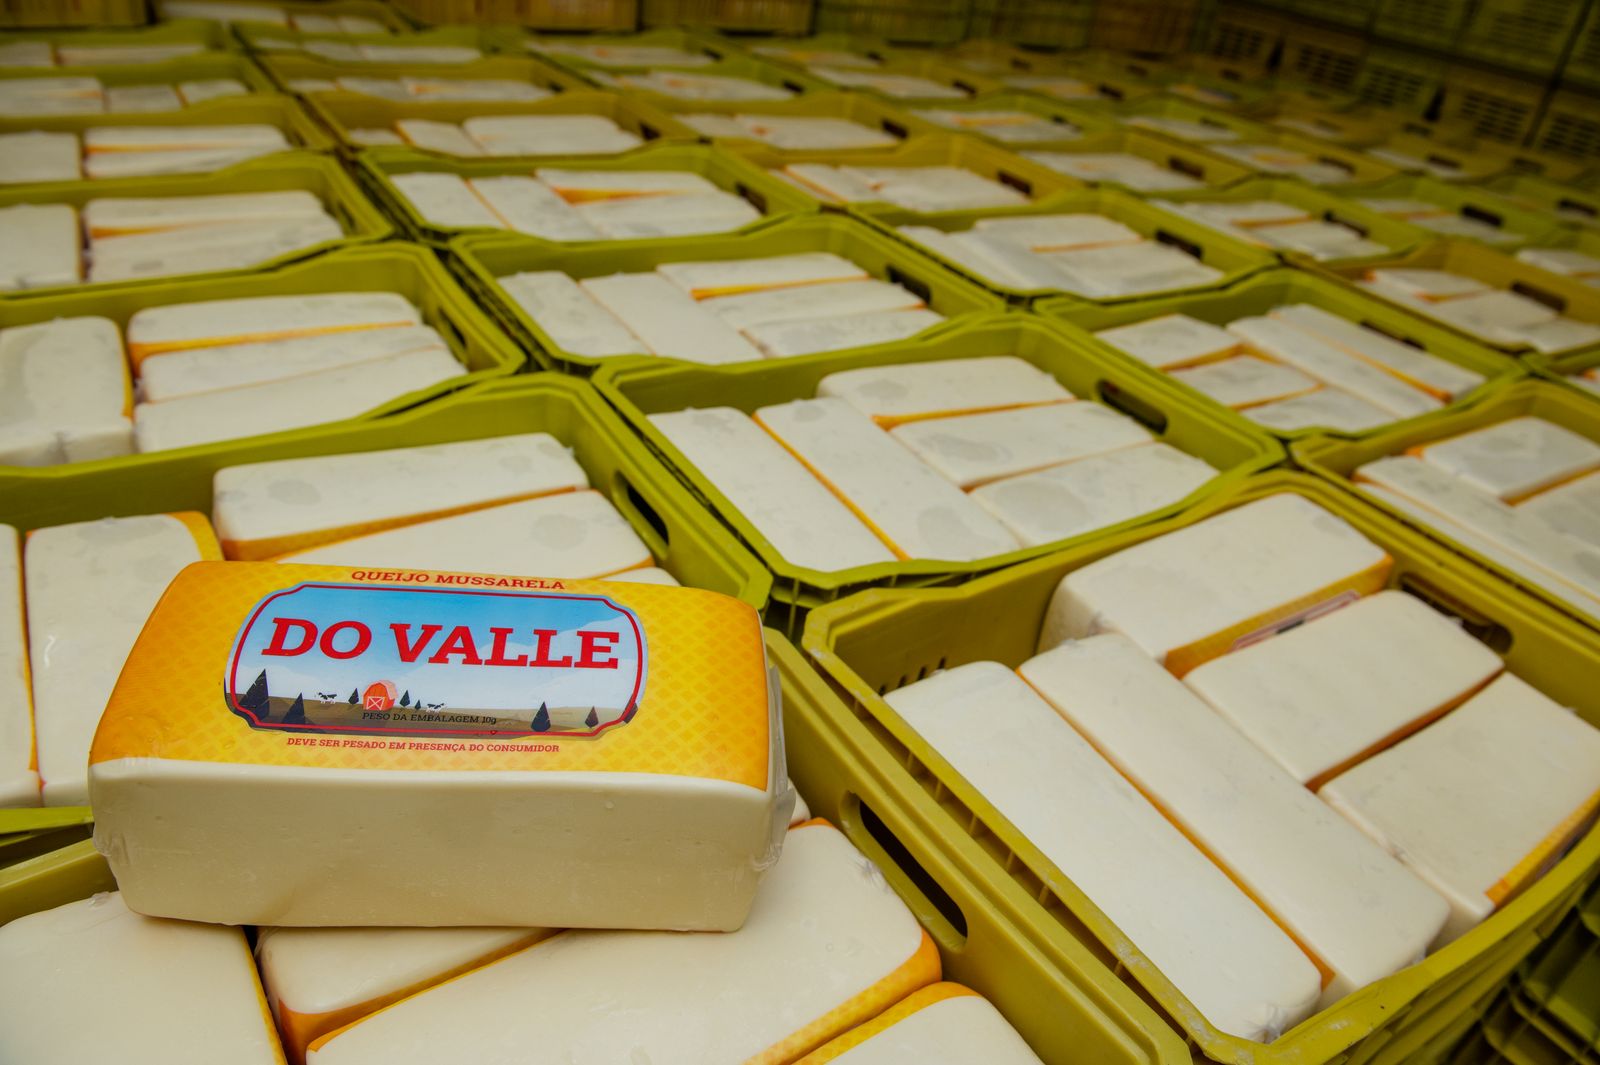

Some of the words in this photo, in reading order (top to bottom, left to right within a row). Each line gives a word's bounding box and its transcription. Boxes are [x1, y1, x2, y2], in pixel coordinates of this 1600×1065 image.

[351, 570, 429, 583] QUEIJO
[436, 574, 565, 590] MUSSARELA
[261, 617, 372, 660] DO
[389, 623, 620, 669] VALLE
[362, 712, 391, 721] PESO
[393, 713, 407, 721] DA
[410, 713, 480, 723] EMBALAGEM
[481, 715, 497, 725] 10g
[287, 737, 317, 746] DEVE
[320, 739, 340, 748] SER
[343, 740, 386, 749] PESADO
[388, 741, 406, 750] EM
[408, 742, 466, 752] PRESENÇA
[469, 743, 484, 752] DO
[486, 744, 560, 753] CONSUMIDOR
